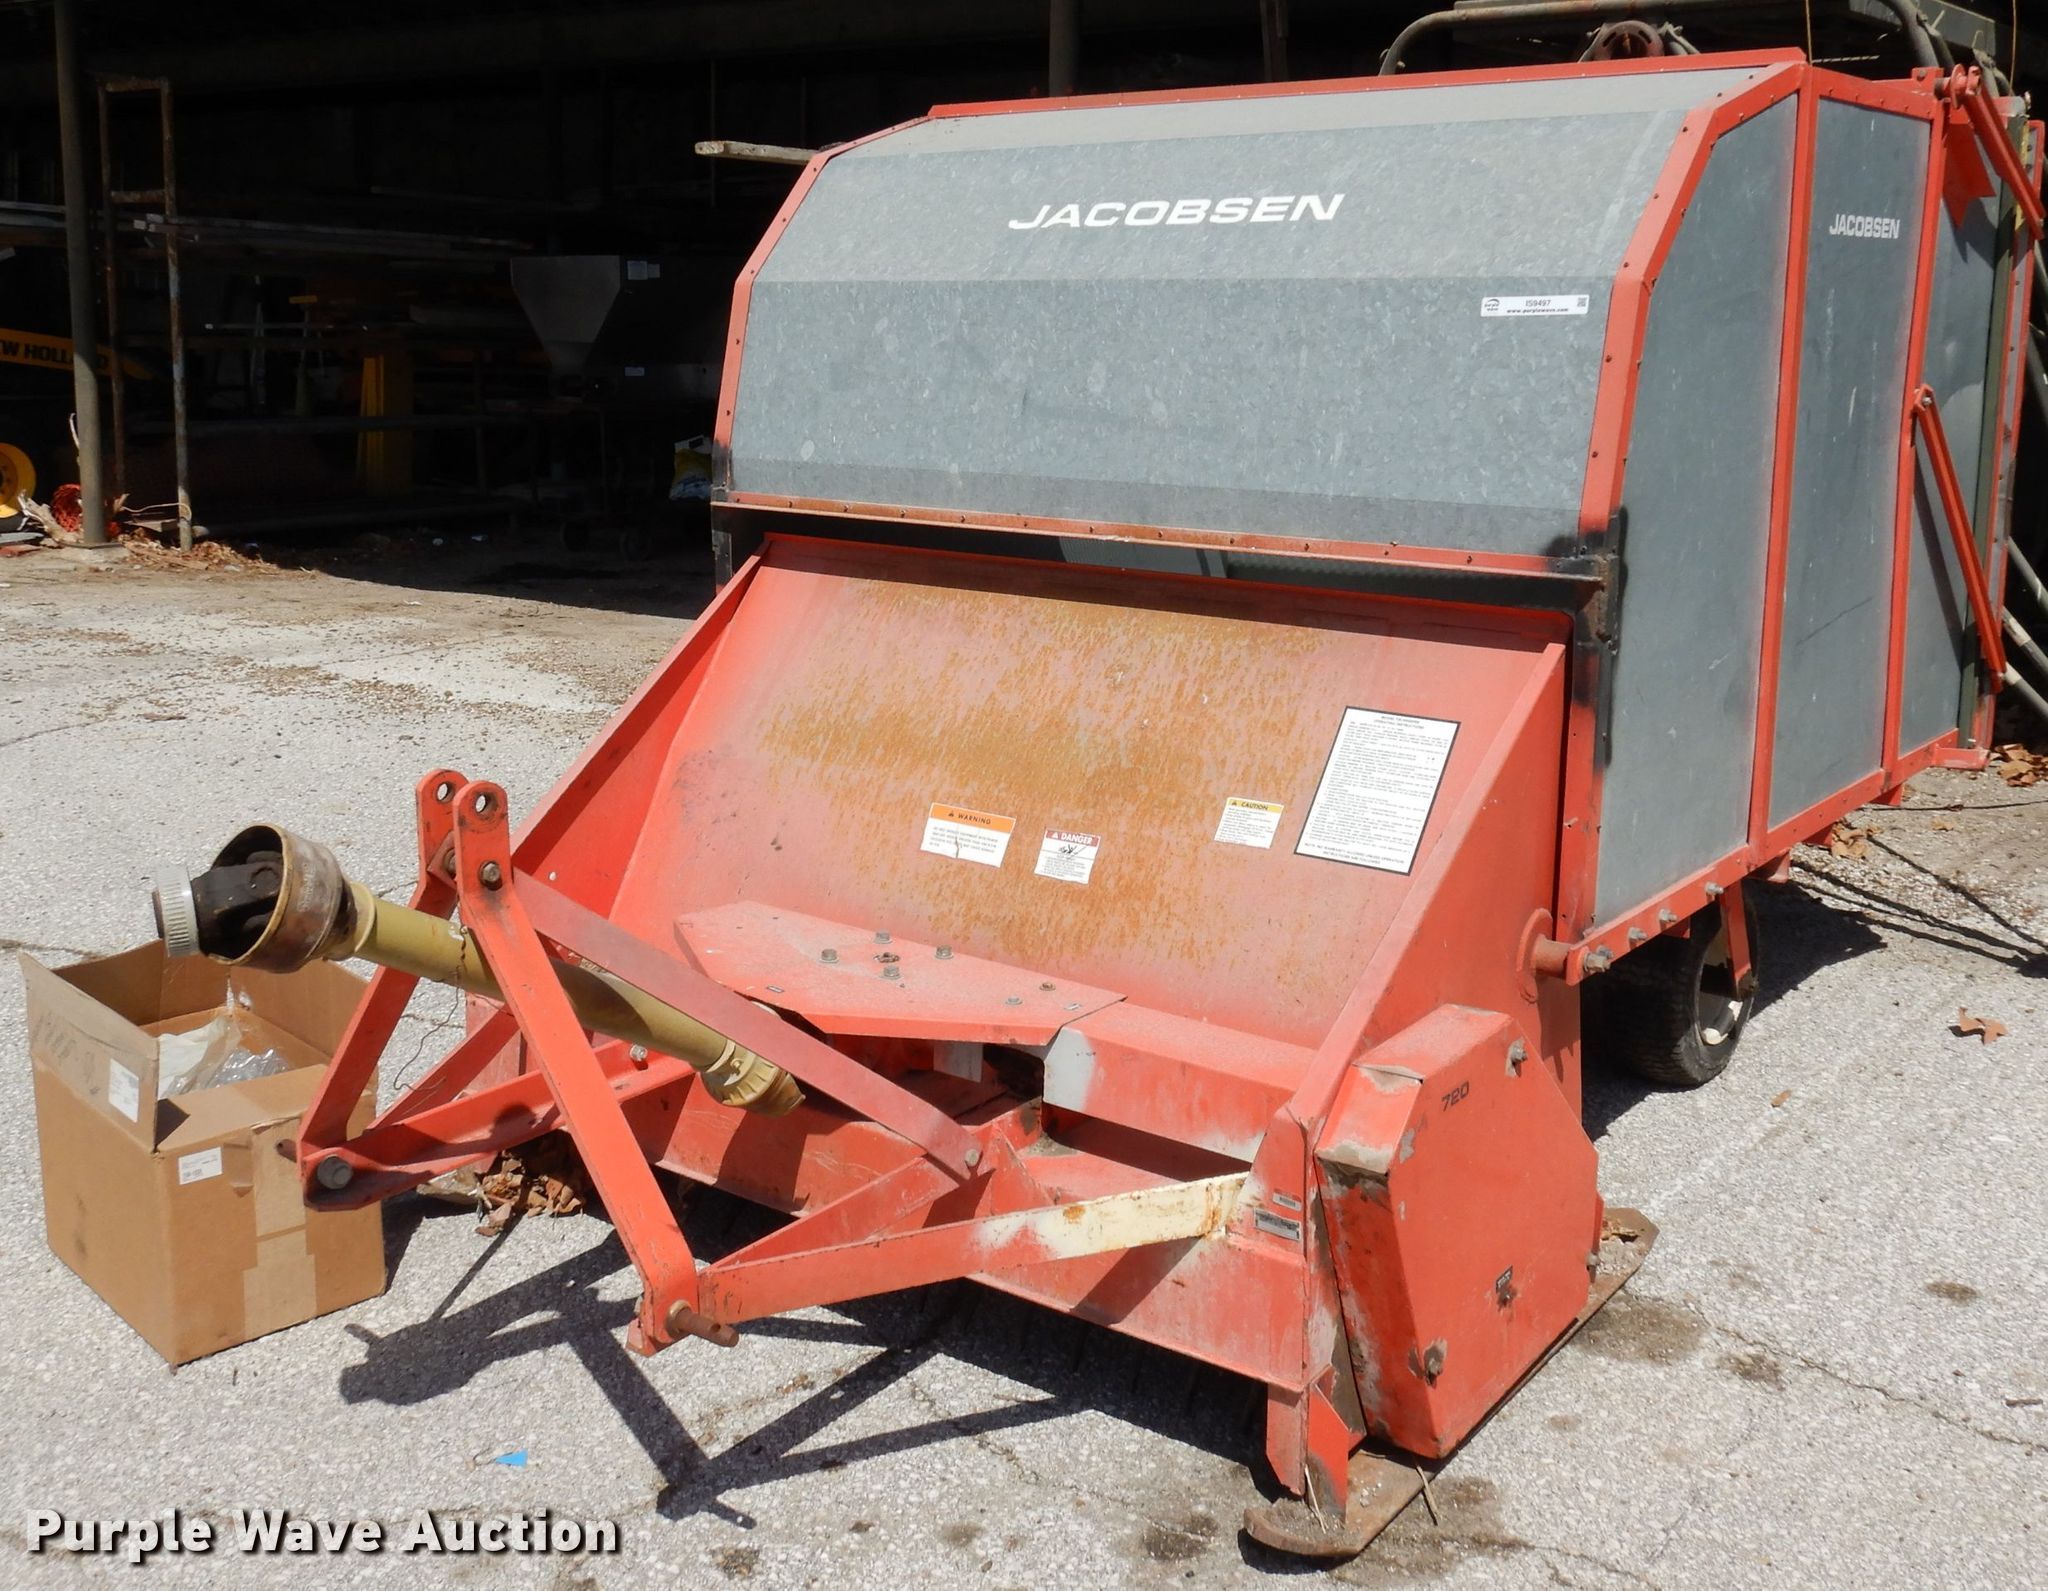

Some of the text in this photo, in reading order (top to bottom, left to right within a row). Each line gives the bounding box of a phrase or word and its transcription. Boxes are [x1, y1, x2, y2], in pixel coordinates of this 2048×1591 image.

[1008, 193, 1345, 230] JACOBSEN
[1829, 213, 1901, 239] JACOBSEN
[958, 812, 991, 825] WARNING
[1061, 832, 1093, 845] DANGER
[1441, 1079, 1470, 1112] 720
